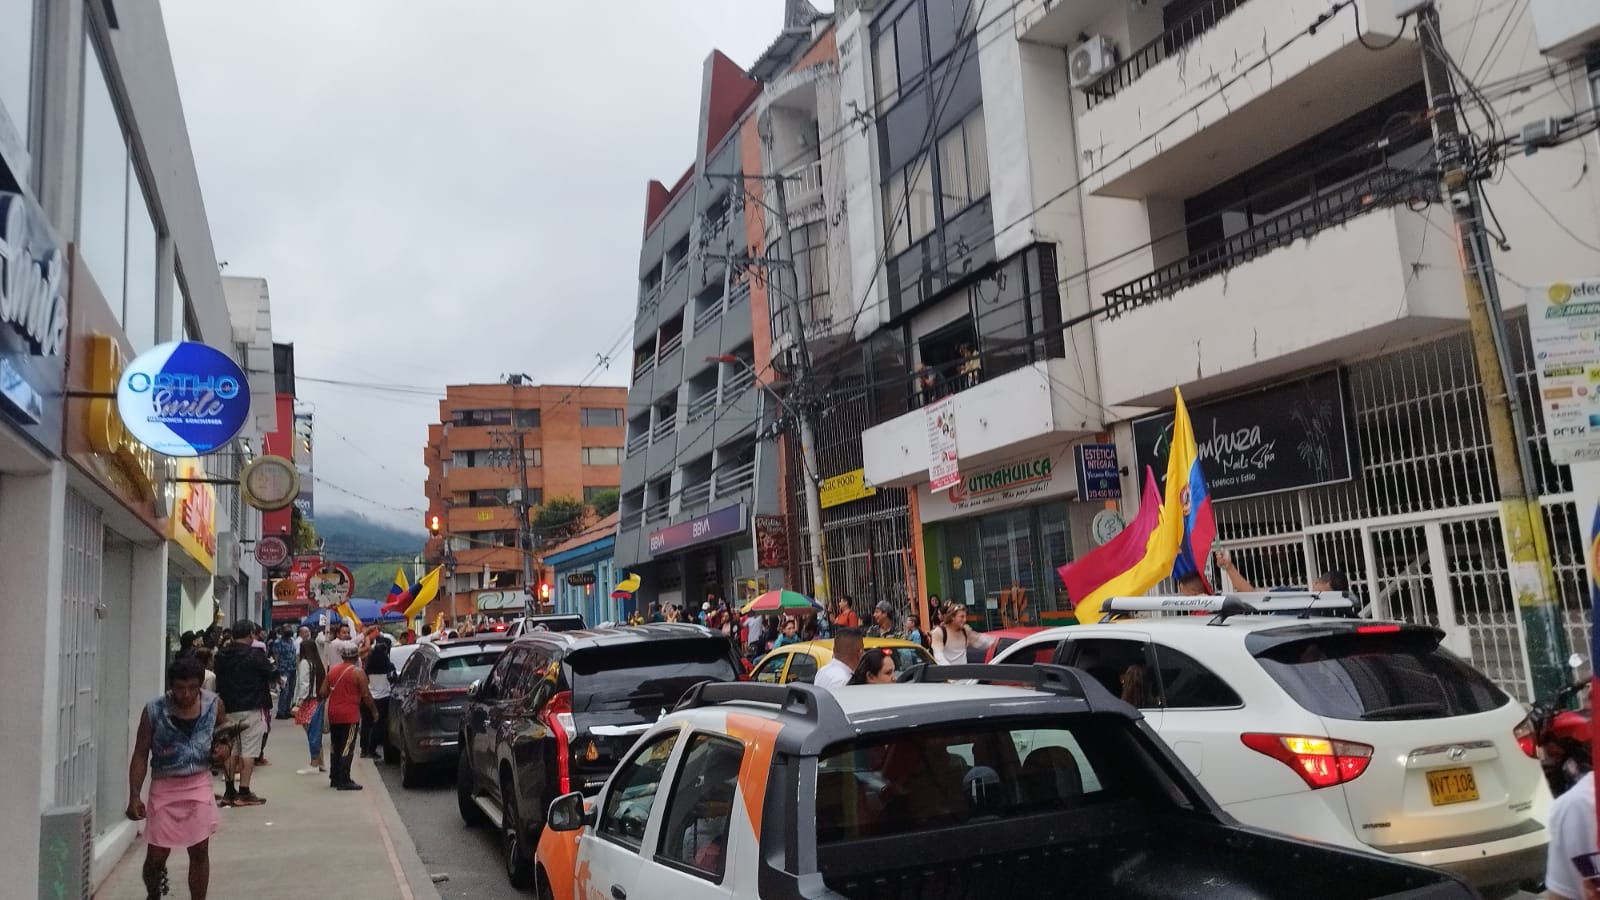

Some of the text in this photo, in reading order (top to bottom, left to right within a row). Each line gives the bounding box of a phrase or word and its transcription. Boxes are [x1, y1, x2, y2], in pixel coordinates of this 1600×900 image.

[128, 372, 239, 400] ORTHO
[152, 387, 225, 418] Smile
[1154, 417, 1262, 465] mbuza
[969, 455, 1051, 492] UTRAHUILCA
[692, 519, 710, 538] BBVA
